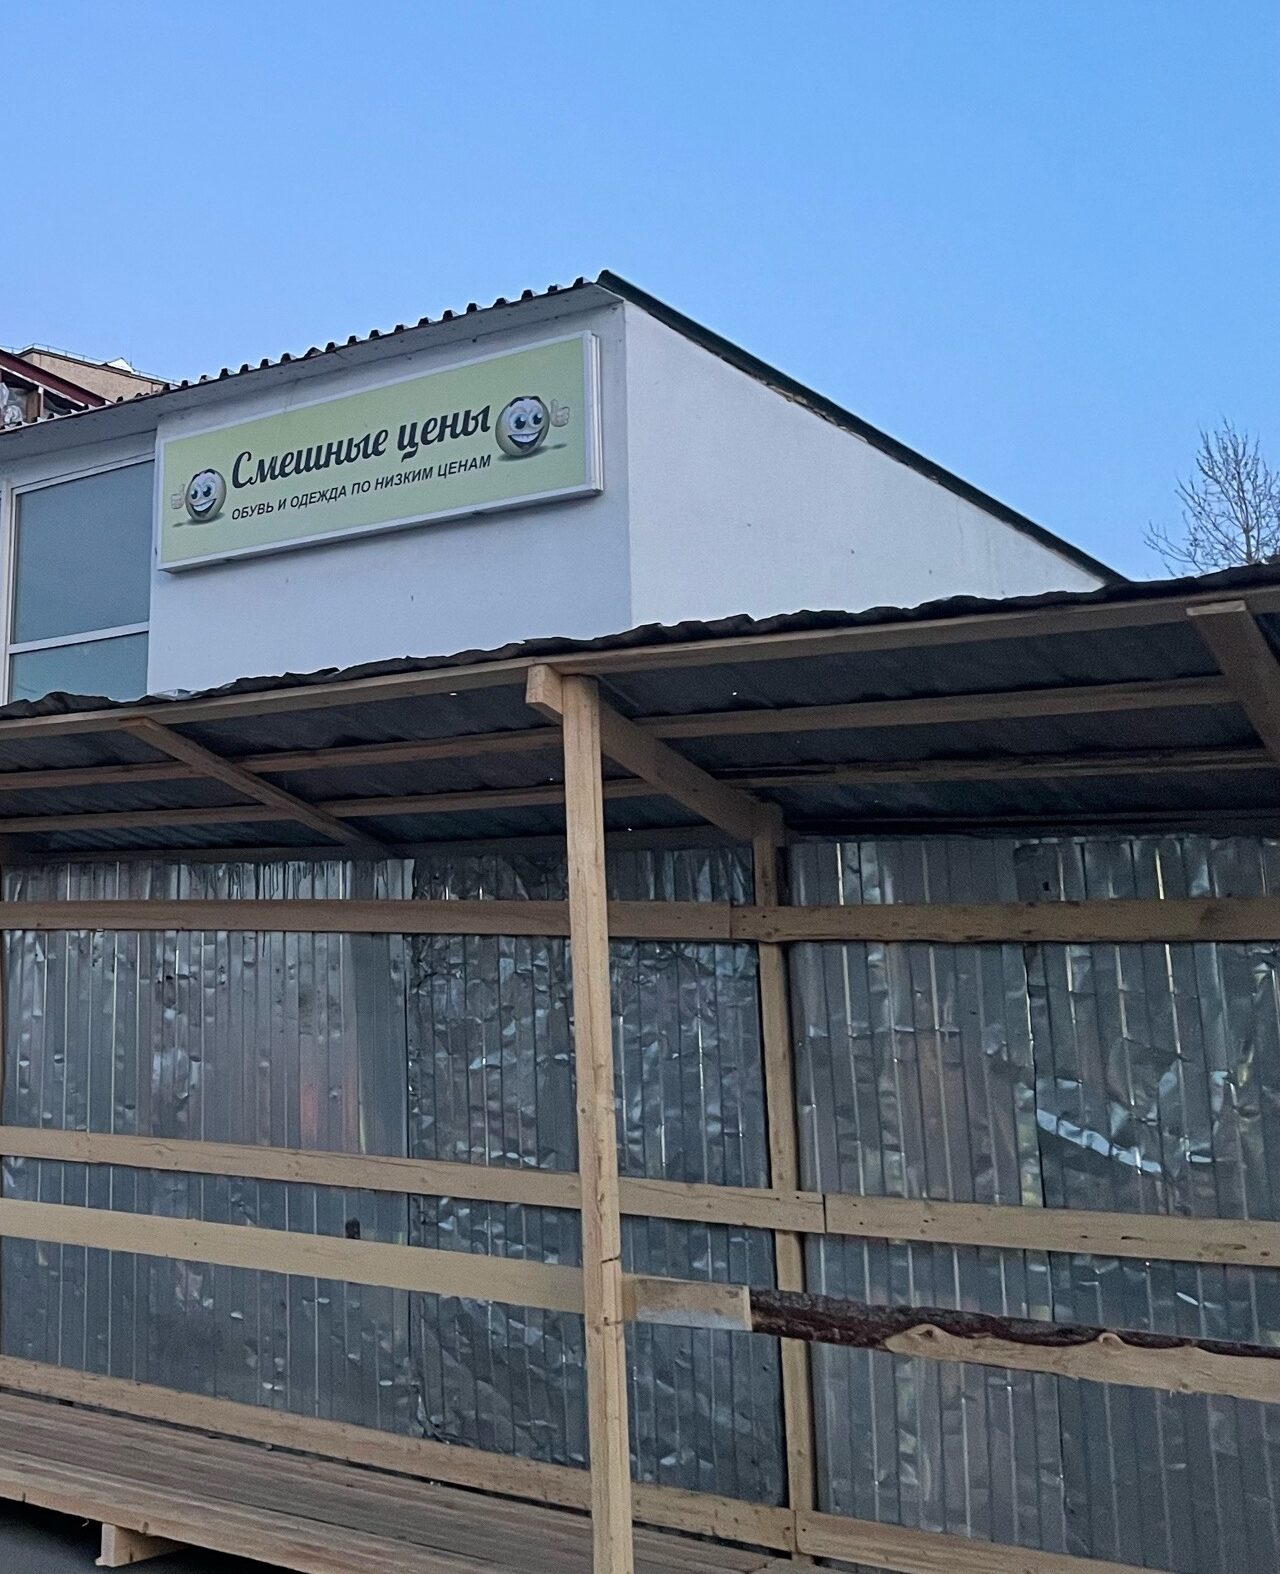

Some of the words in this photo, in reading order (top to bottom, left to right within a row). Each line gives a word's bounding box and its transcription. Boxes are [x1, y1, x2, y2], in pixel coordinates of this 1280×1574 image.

[232, 429, 388, 489] Смешные
[397, 405, 491, 463] цены
[232, 502, 274, 520] ОБУВЬ
[278, 498, 287, 511] И
[290, 485, 347, 509] ОДЕЖДА
[351, 480, 371, 495] ПО
[374, 466, 433, 490] НИЗКИМ
[438, 454, 491, 479] ЦЕНАМ
